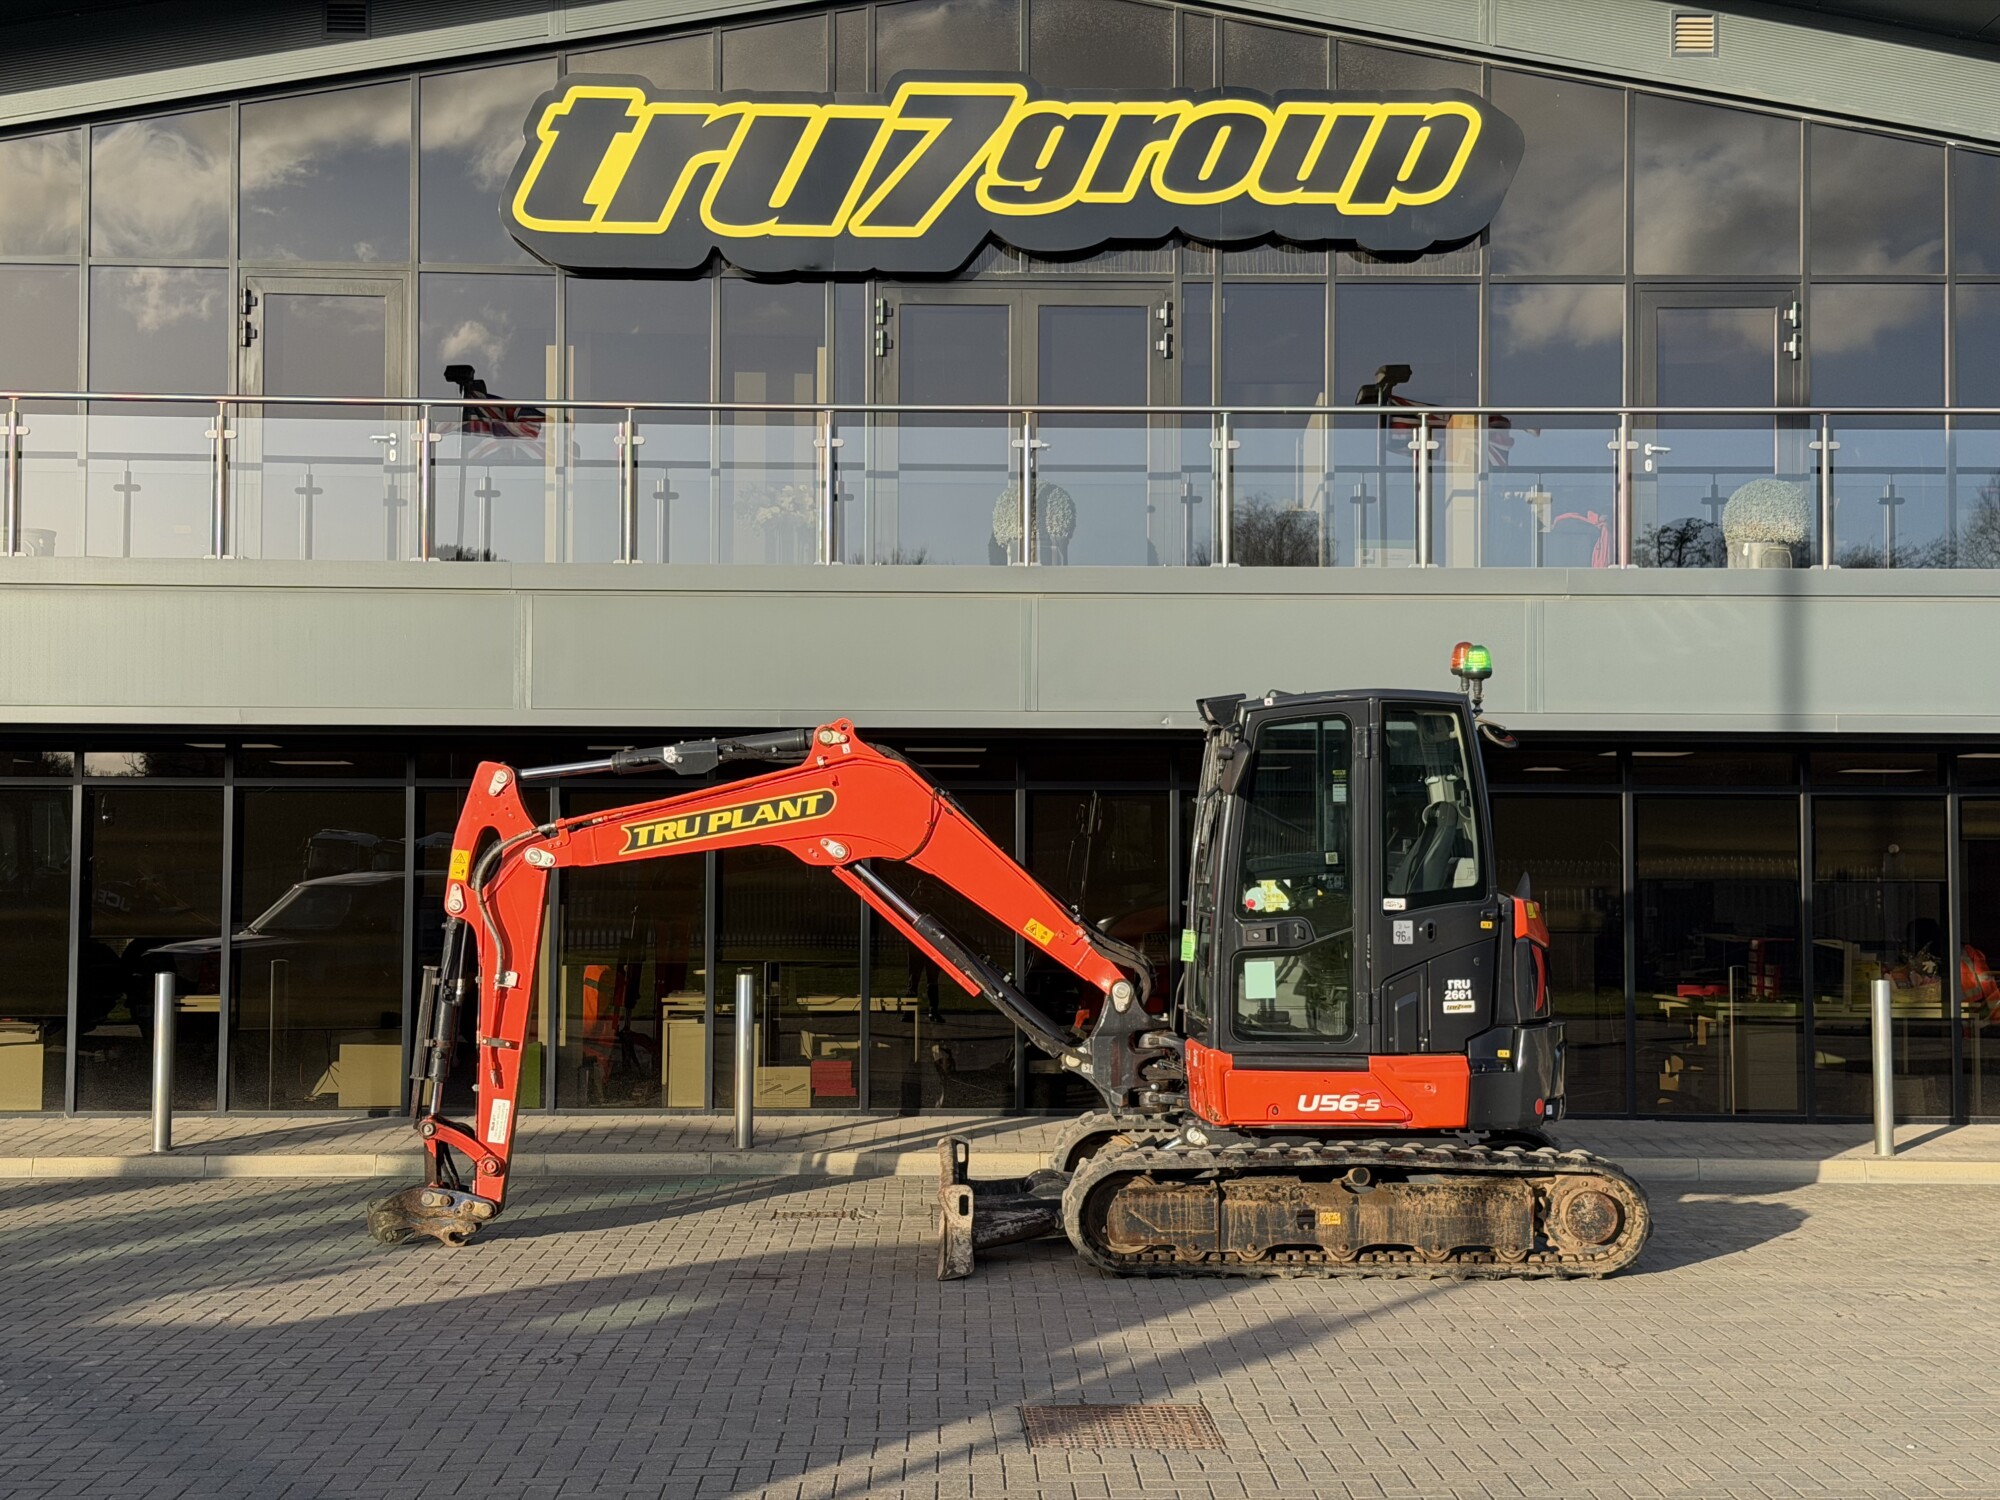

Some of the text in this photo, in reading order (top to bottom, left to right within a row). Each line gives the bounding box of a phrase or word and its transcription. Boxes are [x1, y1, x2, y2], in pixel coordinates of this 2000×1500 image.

[633, 794, 824, 847] TRU PLANT
[1447, 979, 1471, 990] TRU
[1444, 989, 1472, 1001] 2661
